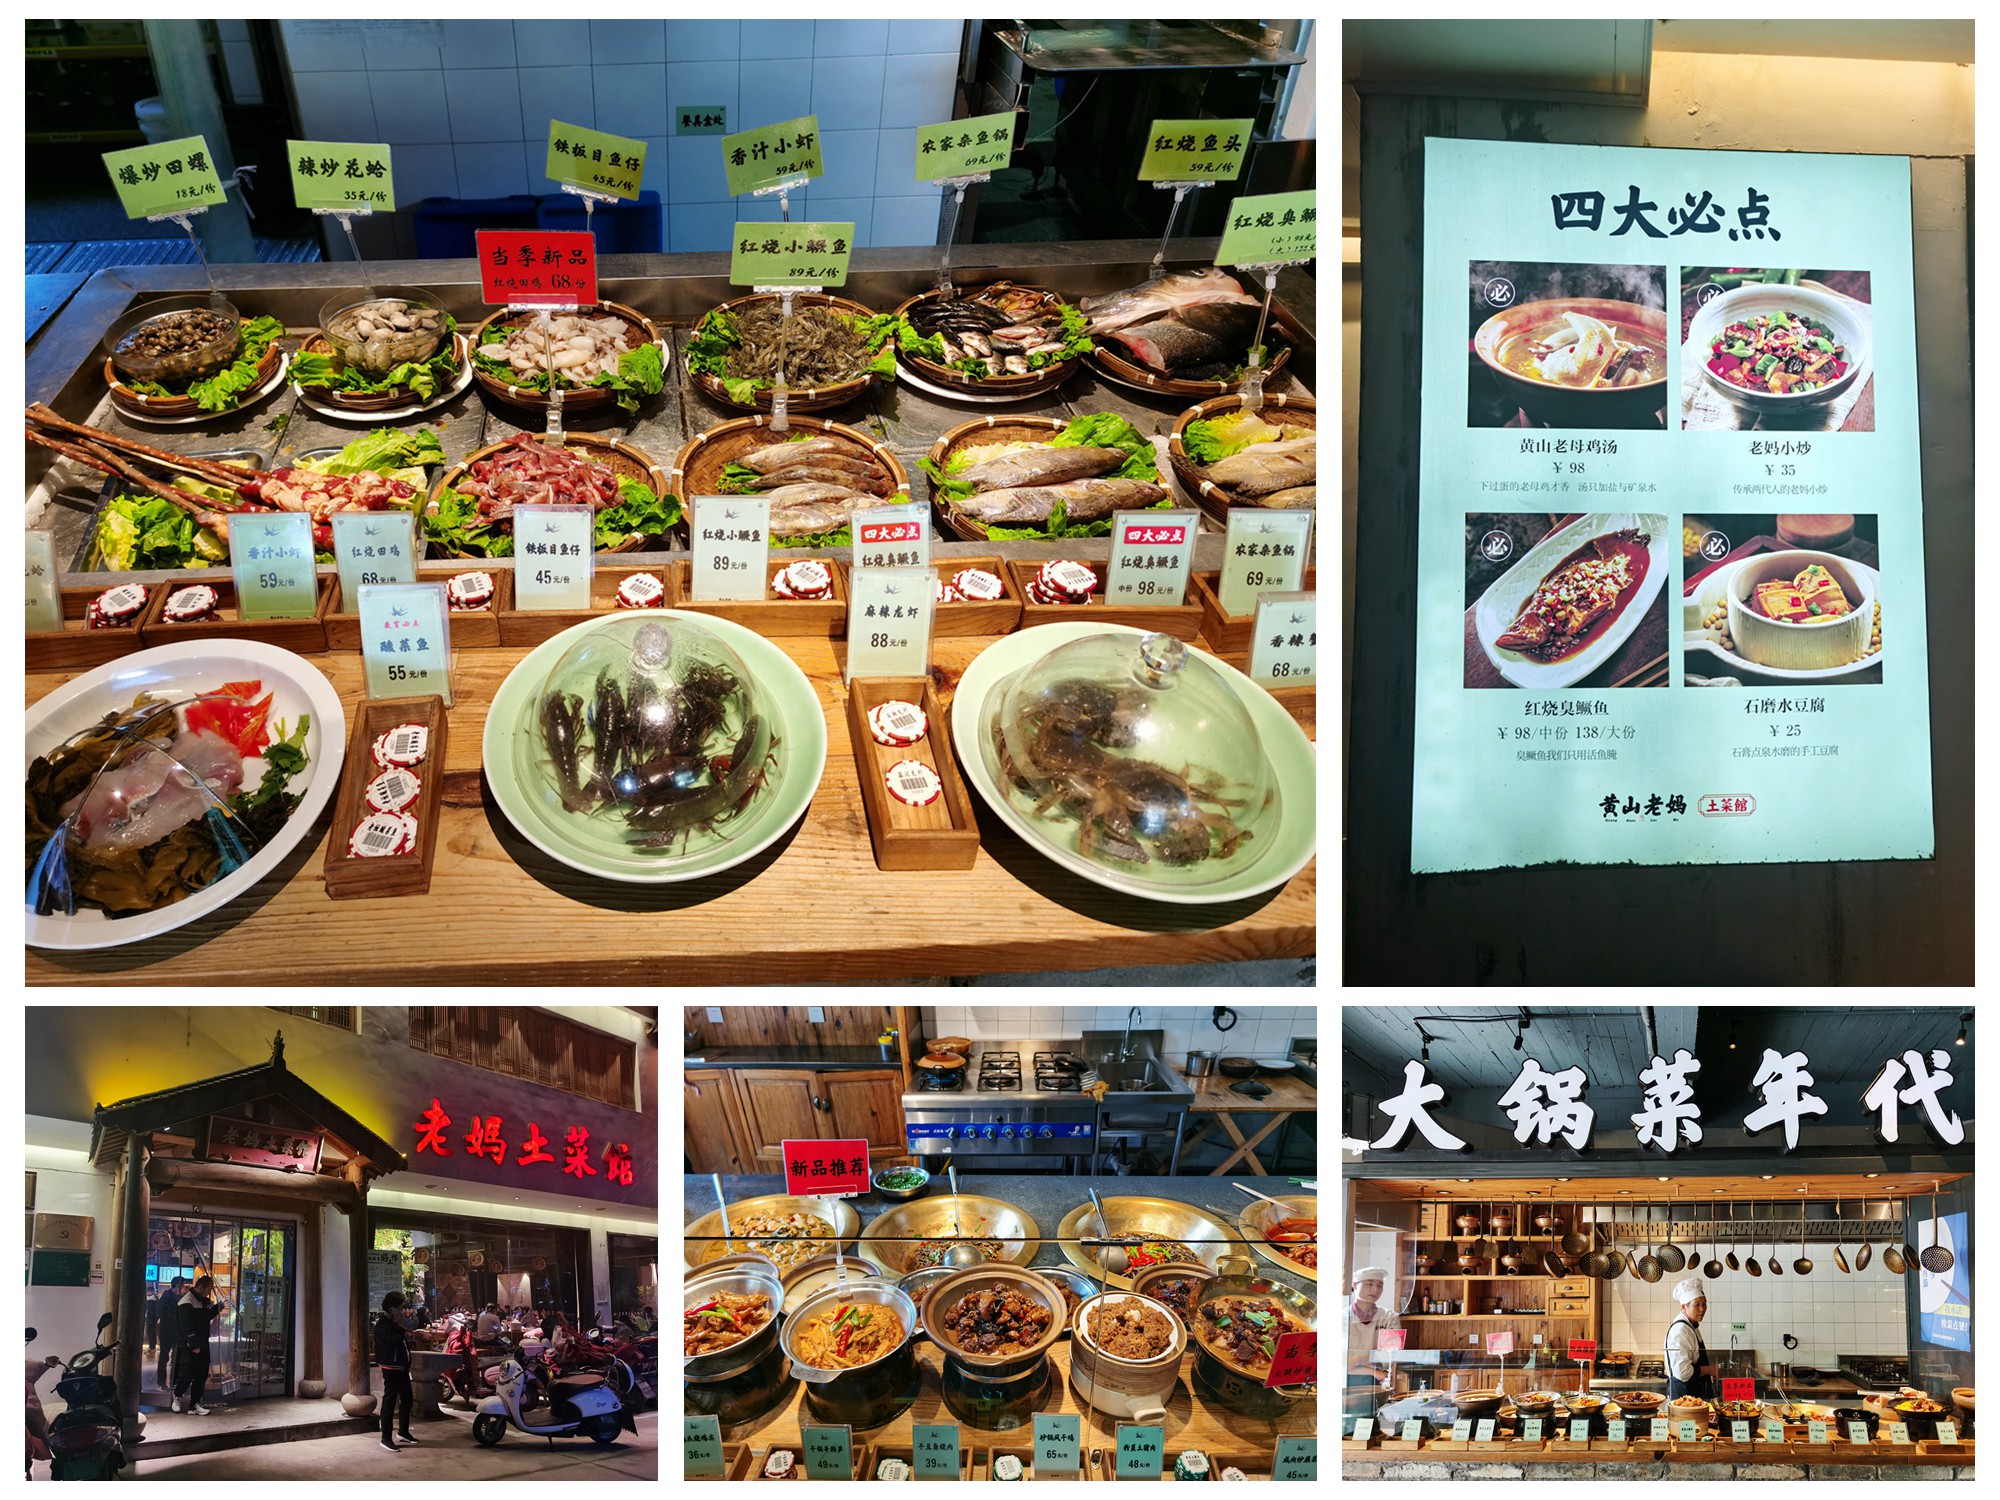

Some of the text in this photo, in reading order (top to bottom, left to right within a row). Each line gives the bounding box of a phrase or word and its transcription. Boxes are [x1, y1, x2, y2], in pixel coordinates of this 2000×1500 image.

[922, 128, 1008, 153] 农家杂鱼锅
[1154, 134, 1242, 152] 红烧鱼头
[553, 138, 640, 171] 铁板目鱼仔
[730, 132, 815, 166] 香汁小虾
[965, 152, 1006, 166] 69元/份
[118, 152, 209, 185] 爆炒田螺
[298, 157, 387, 178] 辣炒花蛤
[776, 159, 815, 176] 59元/份
[1189, 162, 1234, 173] 59元/份
[592, 174, 635, 191] 45元/份
[176, 184, 216, 199] 18元/份
[344, 191, 387, 202] 35元/份
[1551, 184, 1782, 242] 四大必点
[492, 247, 588, 267] 当季新品
[789, 267, 840, 278] 89元/份
[494, 277, 542, 289] 红烧田鸡
[1519, 438, 1618, 456] 黄山老母鸡汤
[1748, 440, 1812, 456] 老妈小炒
[1570, 461, 1585, 474] 98
[1781, 464, 1796, 477] 35
[1478, 480, 1657, 494] 下过蛋的老母鸡才香 汤只加盐与矿泉水
[1732, 483, 1828, 495] 传承两代人的老妈小炒
[702, 528, 761, 542] 红烧小鳜鱼
[864, 524, 919, 540] 四大必点
[1128, 529, 1185, 543] 四大必点
[247, 548, 301, 560] 香汁小虾
[352, 545, 400, 558] 红烧田鸡
[525, 542, 580, 556] 铁板目鱼仔
[1235, 543, 1295, 557] 农家杂鱼锅
[713, 556, 747, 571] 89元/份
[1121, 556, 1179, 570] 红烧臭鳜鱼
[260, 573, 295, 589] 59元/份
[535, 570, 570, 585] 45元/份
[1246, 571, 1283, 586] 69元/份
[864, 604, 919, 618] 麻辣龙虾
[380, 637, 429, 653] 酸菜鱼
[870, 633, 908, 648] 88元/份
[388, 665, 427, 681] 55元/份
[1272, 663, 1311, 678] 68元/份
[1524, 700, 1609, 717] 红烧臭鳜鱼
[1744, 697, 1825, 715] 石磨水豆腐
[1515, 725, 1568, 741] 98/中份
[1575, 725, 1636, 741] 138/大份
[1786, 724, 1801, 737] 25
[1516, 750, 1617, 761] 臭鳜鱼我们只用活鱼腌
[1732, 745, 1838, 758] 石膏点泉水磨的手工豆腐
[1599, 793, 1687, 818] 黄山老妈
[1371, 1048, 1966, 1153] 大锅菜年代
[790, 1157, 866, 1178] 新品推荐
